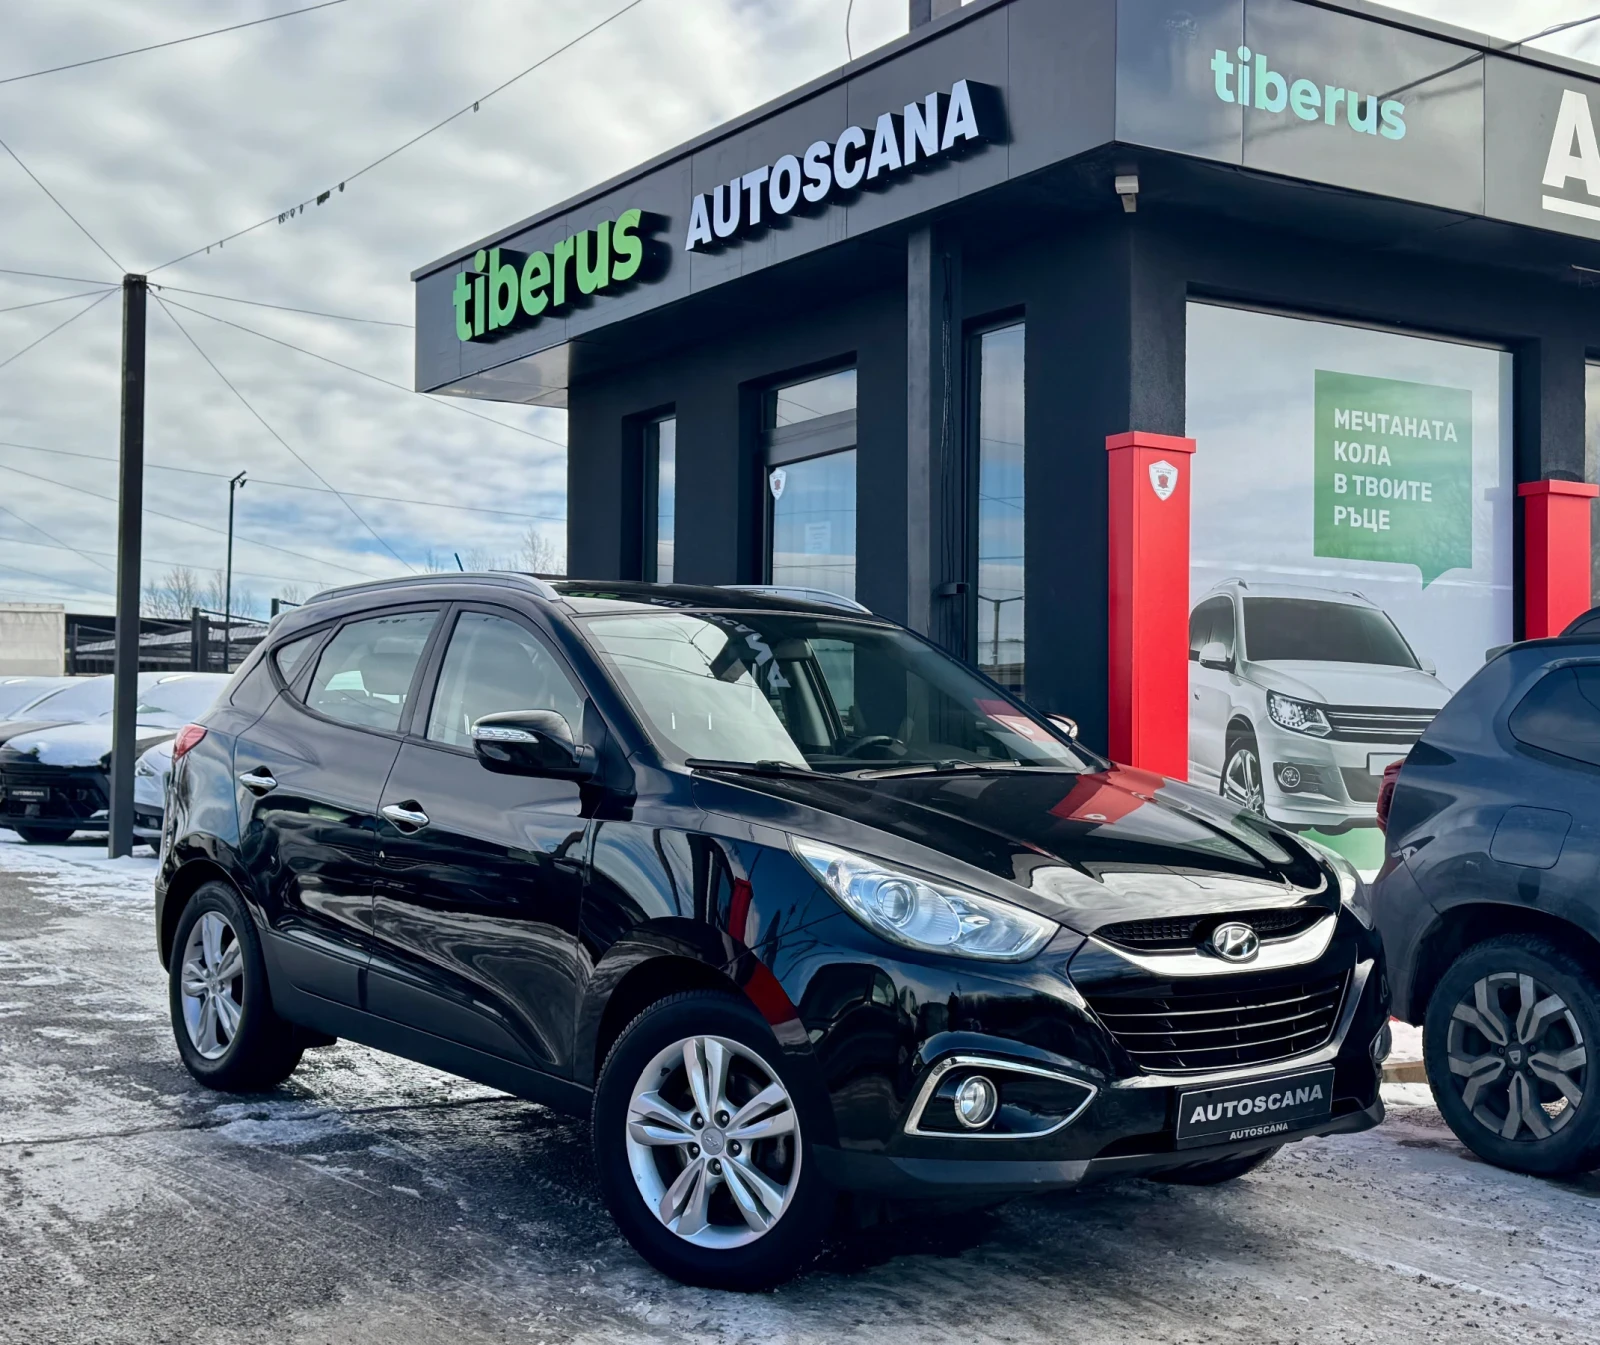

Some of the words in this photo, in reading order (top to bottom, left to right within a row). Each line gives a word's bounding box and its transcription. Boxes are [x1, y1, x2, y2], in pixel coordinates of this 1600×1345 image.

[1210, 46, 1407, 141] tiberus
[685, 79, 979, 251] AUTOSCANA
[453, 208, 643, 341] tiberus
[1334, 408, 1458, 442] МЕЧТАНАТА
[1334, 440, 1391, 466] КОЛА
[1334, 473, 1347, 493] В
[1352, 475, 1432, 502] ТВОИТЕ
[1334, 505, 1390, 532] РЪЦЕ
[1190, 1084, 1323, 1123] AUTOSCANA
[1229, 1122, 1288, 1140] AUTOSCANA
